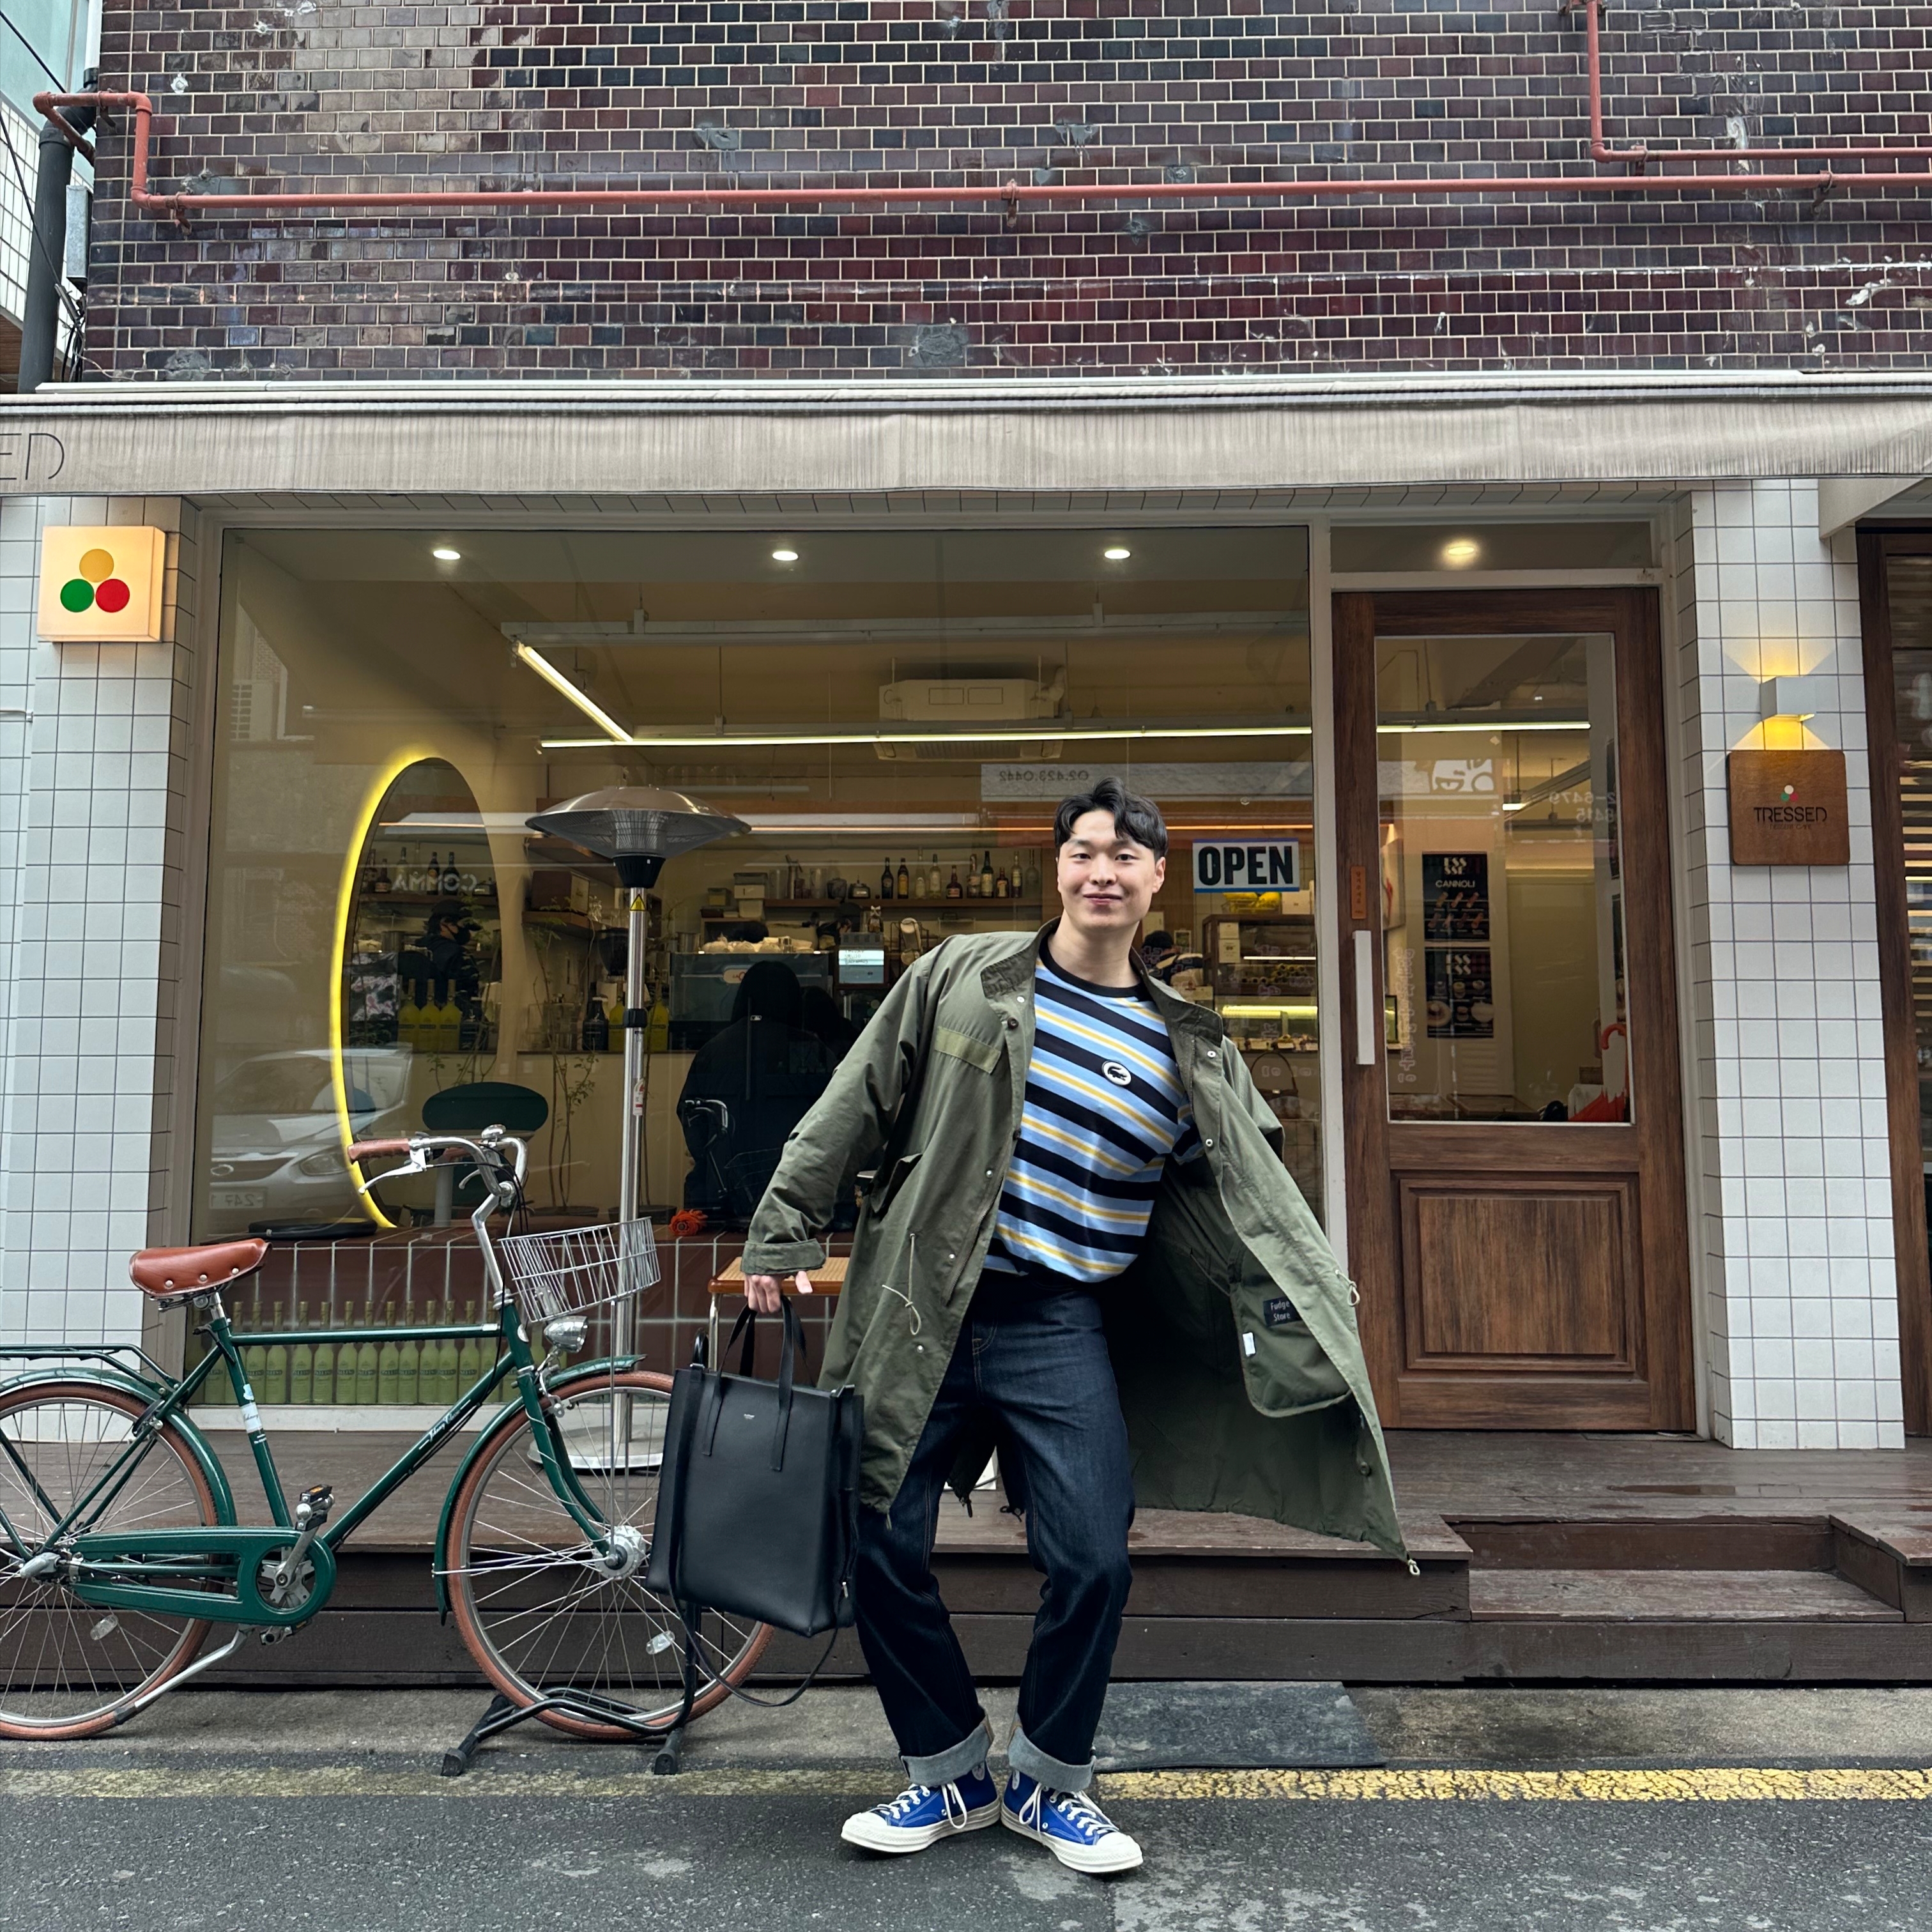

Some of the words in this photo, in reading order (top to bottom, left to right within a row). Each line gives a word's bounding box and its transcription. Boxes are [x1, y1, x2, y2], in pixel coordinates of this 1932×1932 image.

[1753, 806, 1827, 822] TRESSED
[1198, 845, 1293, 886] OPEN
[1435, 880, 1475, 888] CANNOLI
[1270, 1300, 1290, 1311] Fudge
[1273, 1313, 1291, 1322] Store
